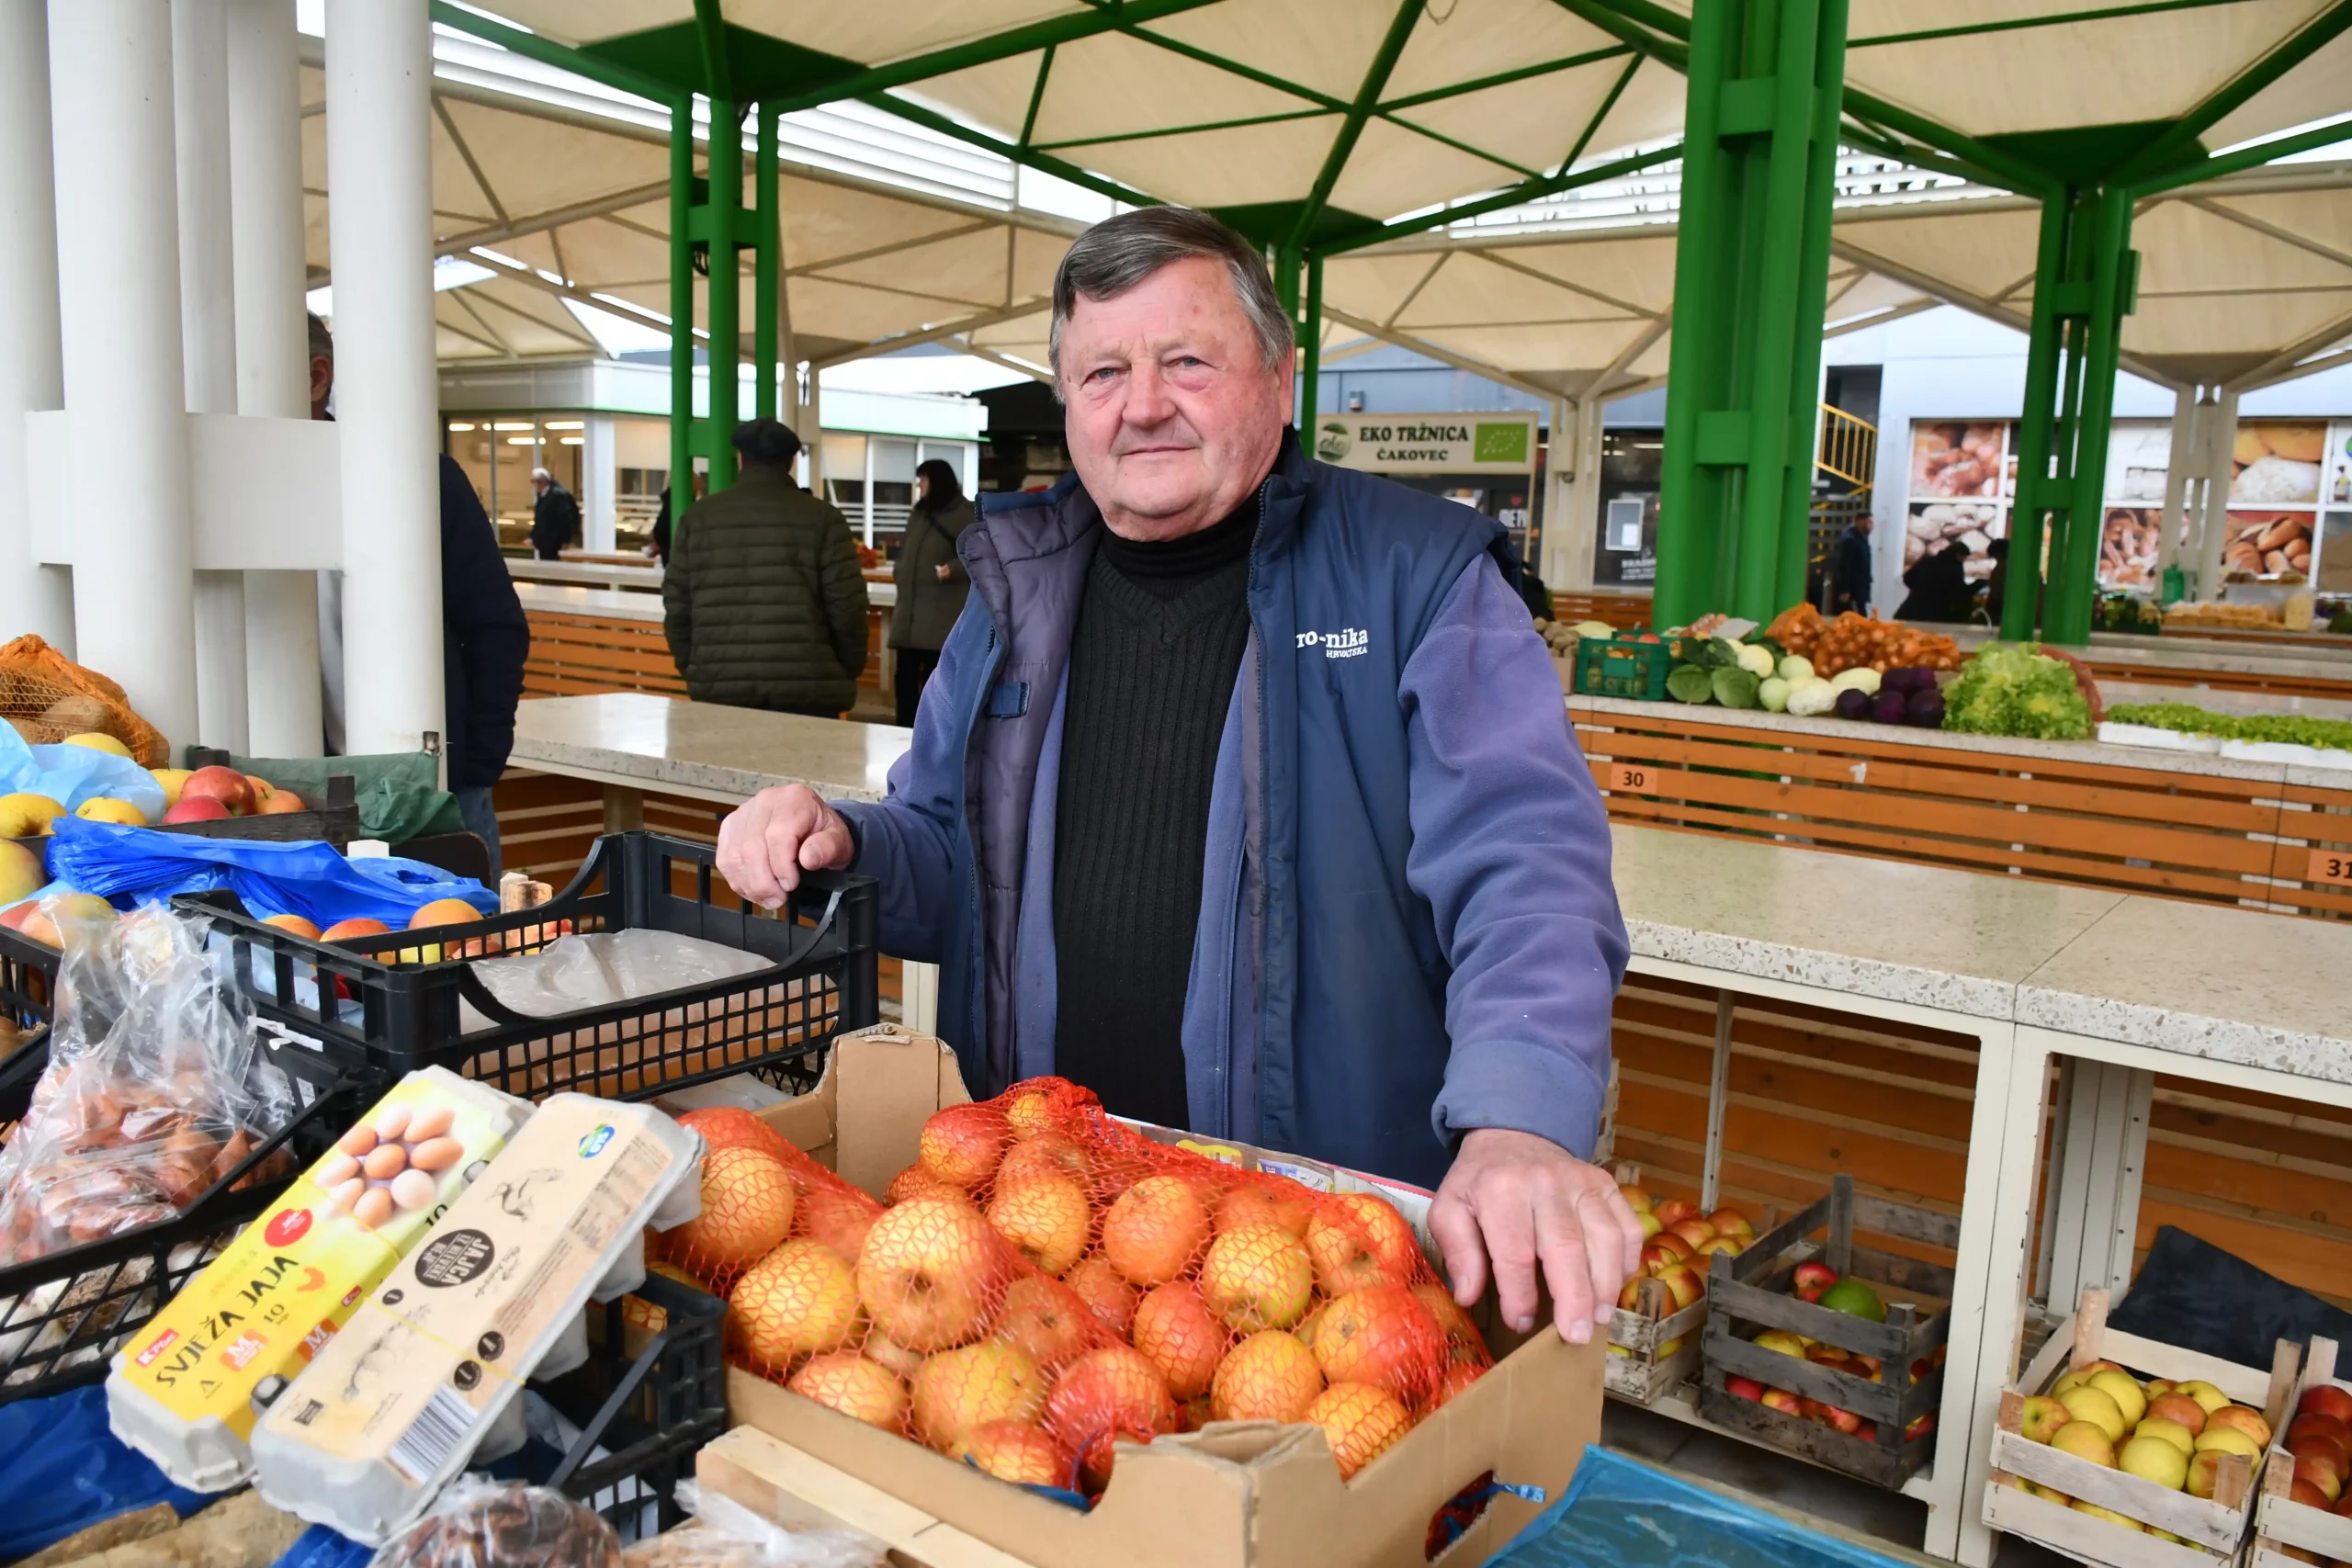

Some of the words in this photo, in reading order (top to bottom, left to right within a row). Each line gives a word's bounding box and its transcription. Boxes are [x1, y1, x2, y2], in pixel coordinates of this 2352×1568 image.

[1360, 426, 1392, 442] EKO
[1396, 423, 1469, 442] TRŽNICA
[1376, 447, 1448, 461] ČAKOVEC
[1326, 647, 1368, 658] HRVATSKA
[1623, 771, 1644, 787] 30
[2326, 859, 2352, 879] 31
[441, 1237, 491, 1284] JAJCA
[156, 1311, 244, 1389] SVJEŽA
[236, 1256, 300, 1308] JAJA
[263, 1303, 285, 1323] 10
